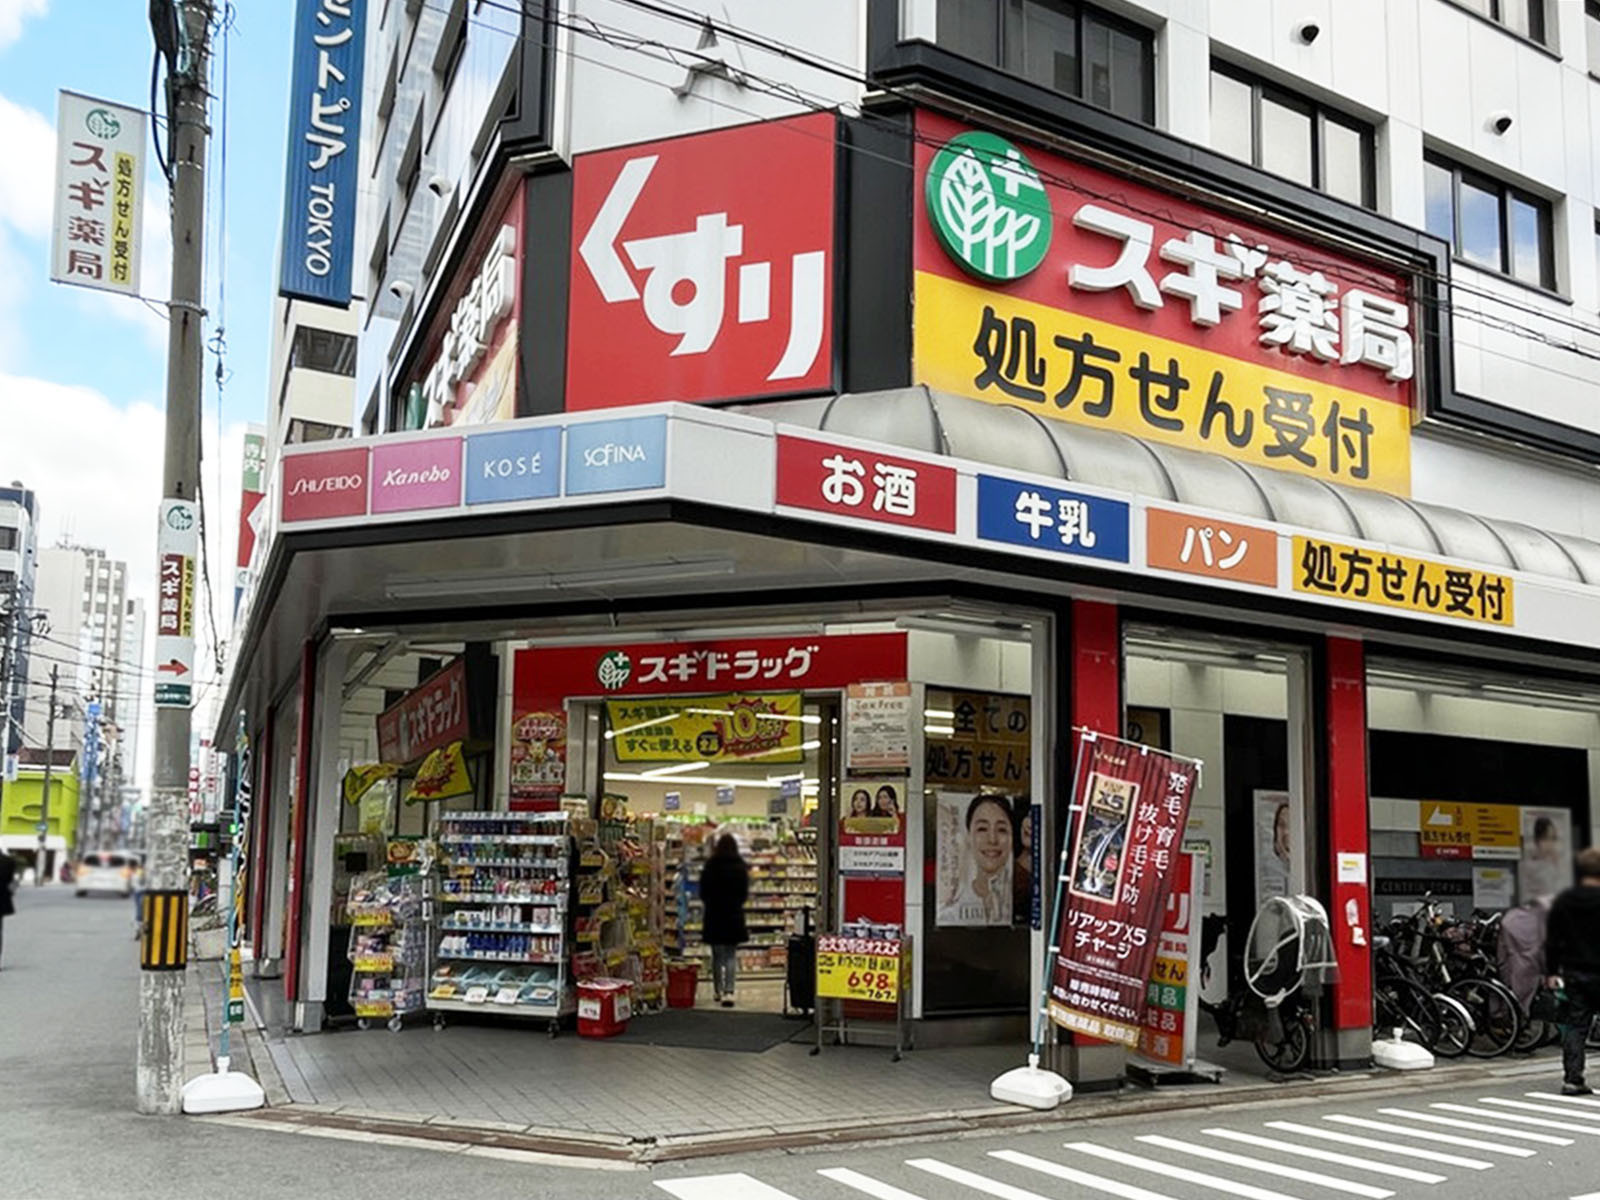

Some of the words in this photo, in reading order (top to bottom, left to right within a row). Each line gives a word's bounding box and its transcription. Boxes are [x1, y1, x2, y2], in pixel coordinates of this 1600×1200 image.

[67, 141, 109, 280] スギ薬局
[112, 157, 133, 281] 処方せん受付
[305, 183, 335, 277] TOKYO
[579, 155, 825, 382] くすり
[1068, 203, 1413, 382] スギ薬局
[972, 305, 1375, 480] 処方せん受付
[288, 474, 362, 496] SHISEIDO
[382, 467, 451, 487] Kanebo
[483, 453, 542, 478] KOSÉ
[821, 454, 917, 518] お酒
[1014, 491, 1096, 548] 牛乳
[1179, 526, 1248, 570] パン
[1301, 540, 1506, 621] 処方せん受付
[637, 645, 819, 683] スギドラッグ
[954, 700, 1027, 733] 全ての
[925, 745, 1031, 780] 処方せん
[1074, 931, 1132, 959] チャージ
[847, 971, 889, 990] 698
